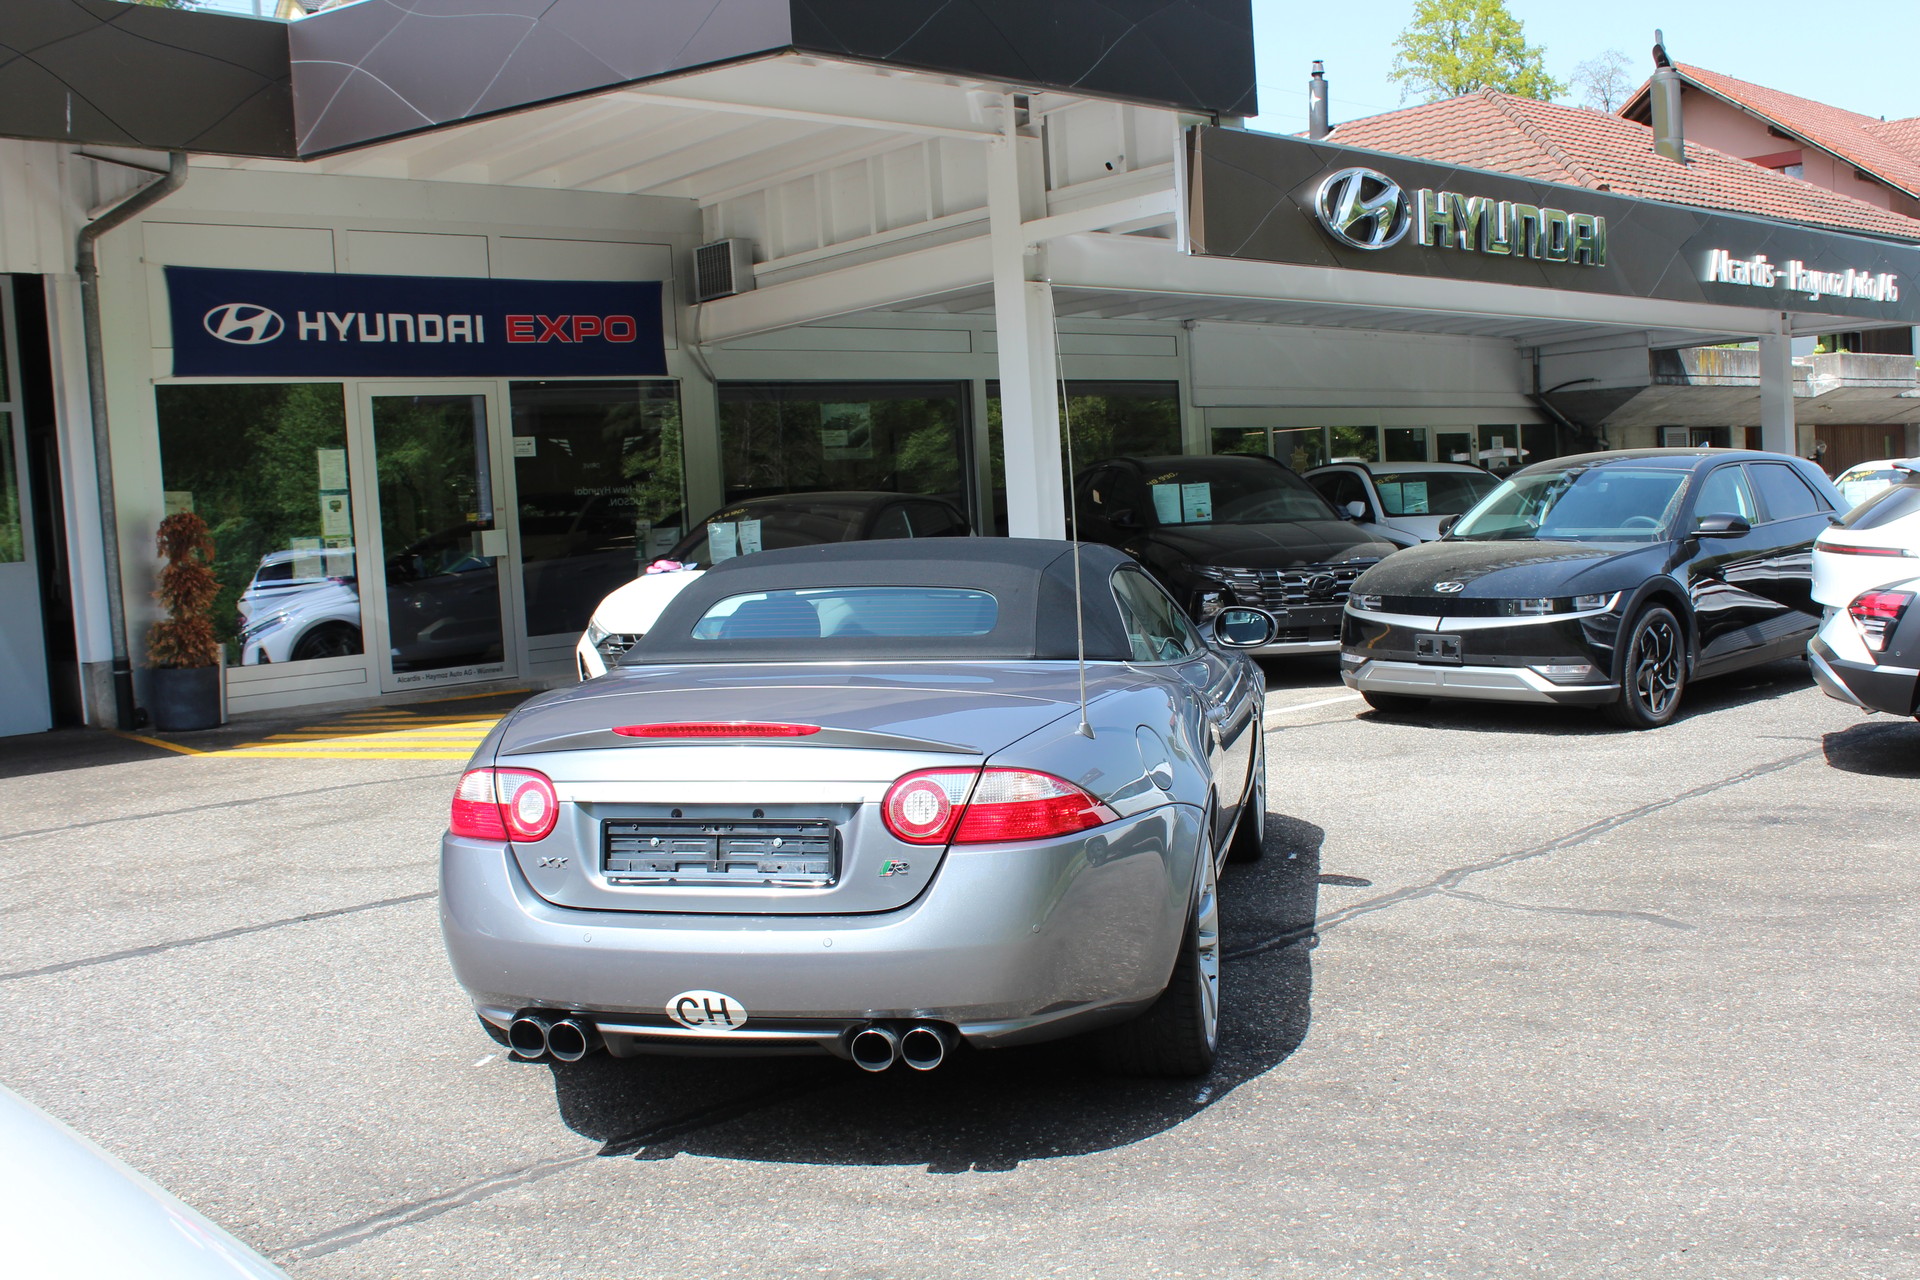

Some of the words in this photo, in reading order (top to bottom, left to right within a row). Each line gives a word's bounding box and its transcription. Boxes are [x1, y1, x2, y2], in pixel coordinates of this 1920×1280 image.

[1418, 188, 1606, 267] HYUNDAI
[299, 311, 485, 343] HYUNDAI
[505, 314, 637, 344] EXPO
[676, 997, 734, 1026] CH
